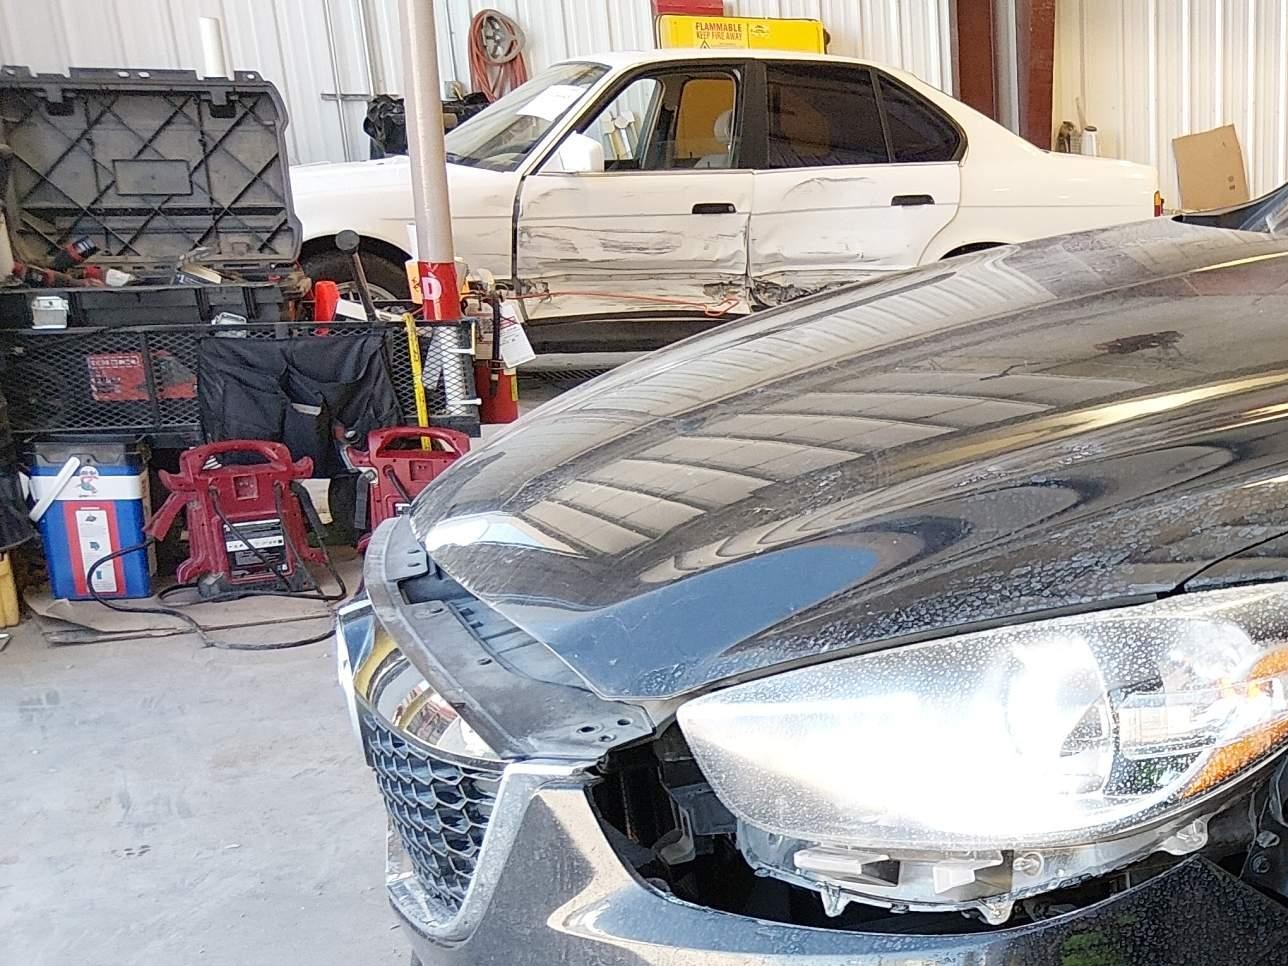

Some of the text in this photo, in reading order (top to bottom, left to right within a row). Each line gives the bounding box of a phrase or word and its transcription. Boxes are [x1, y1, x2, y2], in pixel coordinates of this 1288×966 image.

[695, 22, 742, 32] FLAMMABLE
[712, 32, 725, 40] FIRE
[725, 32, 742, 41] AWAY
